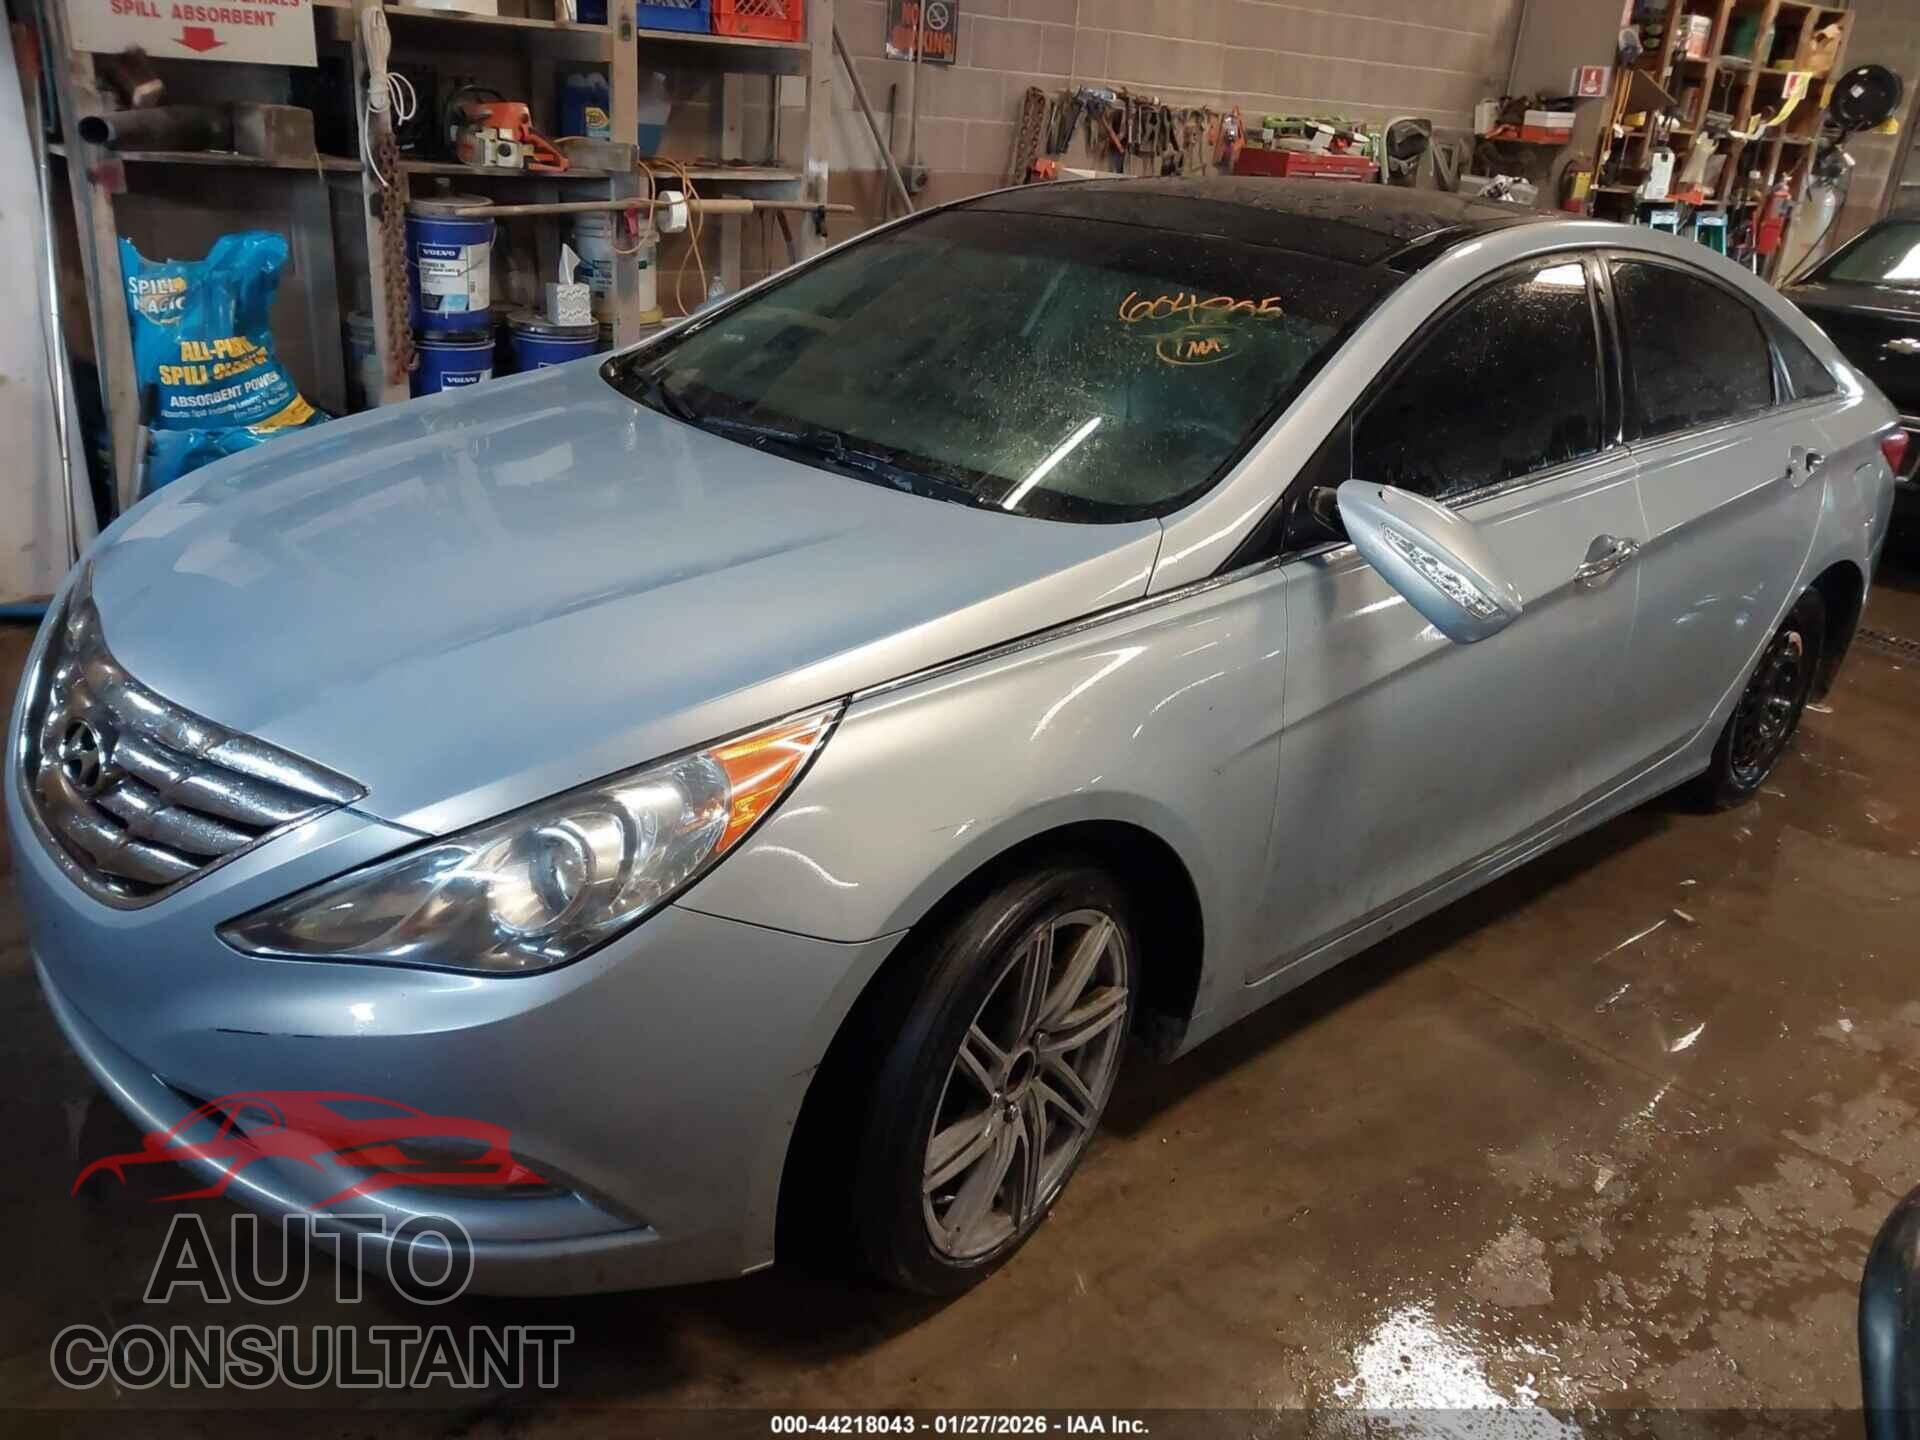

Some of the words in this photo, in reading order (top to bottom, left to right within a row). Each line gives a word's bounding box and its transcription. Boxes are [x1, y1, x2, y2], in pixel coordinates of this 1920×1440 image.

[112, 0, 161, 18] SPILL
[172, 4, 276, 27] ABSORBENT
[423, 248, 456, 257] VOLVO
[447, 376, 477, 384] VOLVO
[170, 385, 242, 408] ABSORBENT
